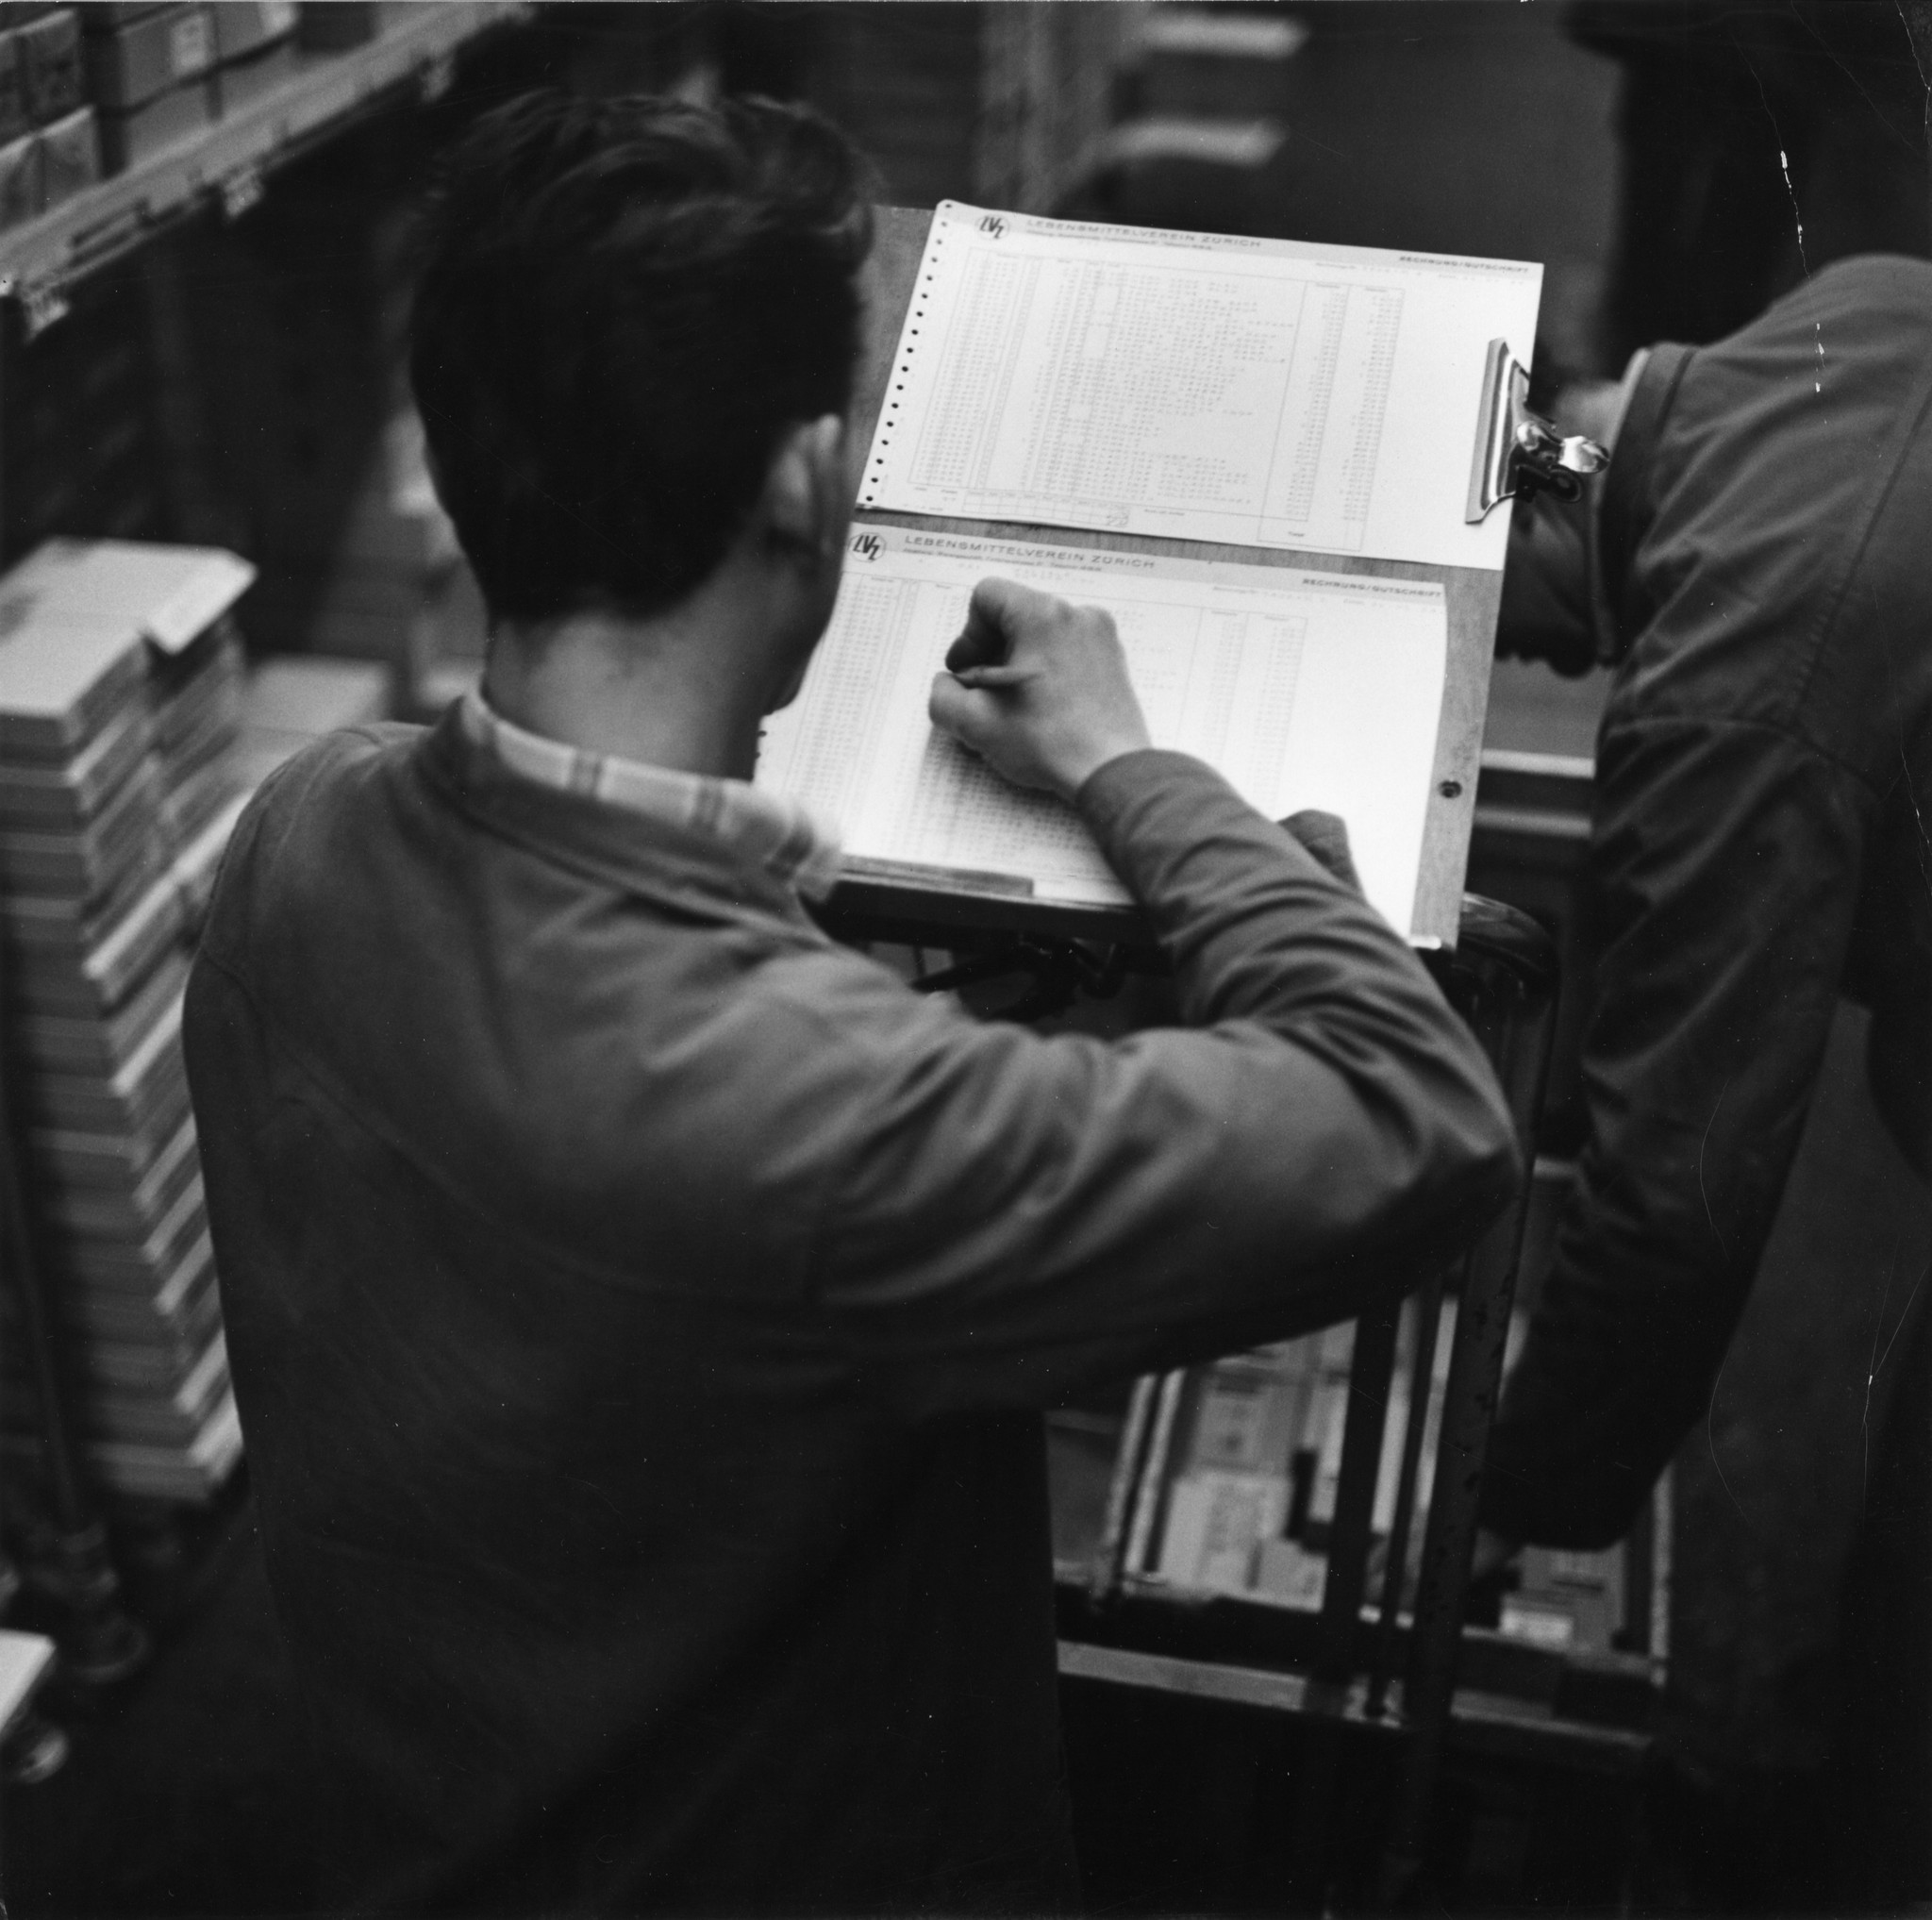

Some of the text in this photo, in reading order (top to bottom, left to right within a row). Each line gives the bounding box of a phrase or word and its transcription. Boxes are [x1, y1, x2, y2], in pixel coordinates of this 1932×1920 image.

[1026, 219, 1195, 242] LEBENSMITTELVEREIN
[905, 535, 1084, 561] LEBENSMITTELVEREIN
[1302, 577, 1443, 598] RECHNUNG/GUTSCHRIFT
